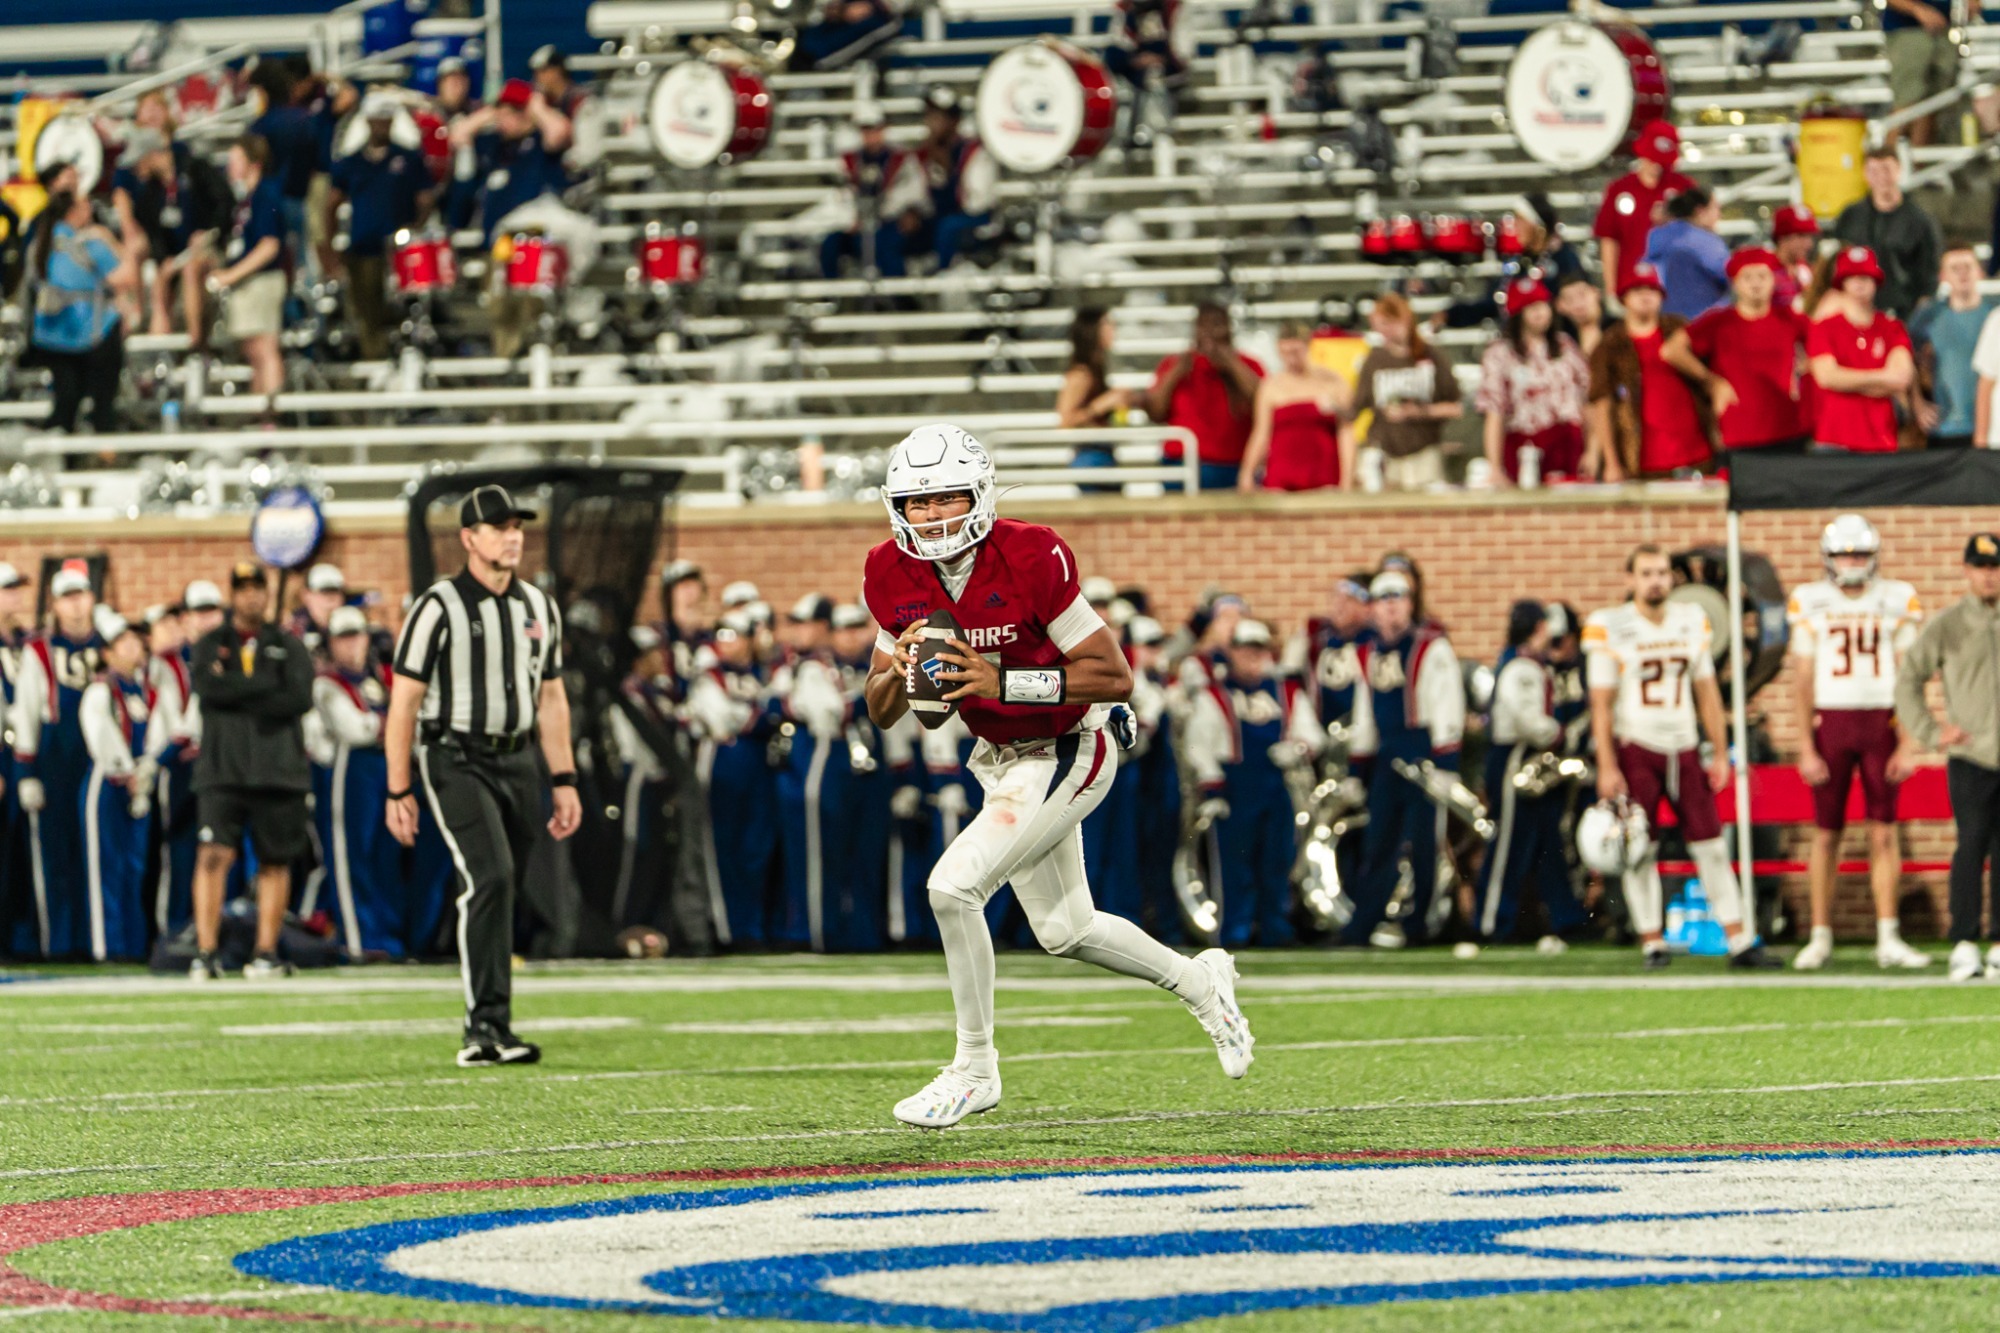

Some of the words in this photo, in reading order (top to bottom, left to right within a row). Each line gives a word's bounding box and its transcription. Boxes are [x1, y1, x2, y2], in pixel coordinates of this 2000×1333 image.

[1051, 543, 1069, 582] 1
[1828, 625, 1880, 678] 34
[1640, 655, 1689, 706] 27
